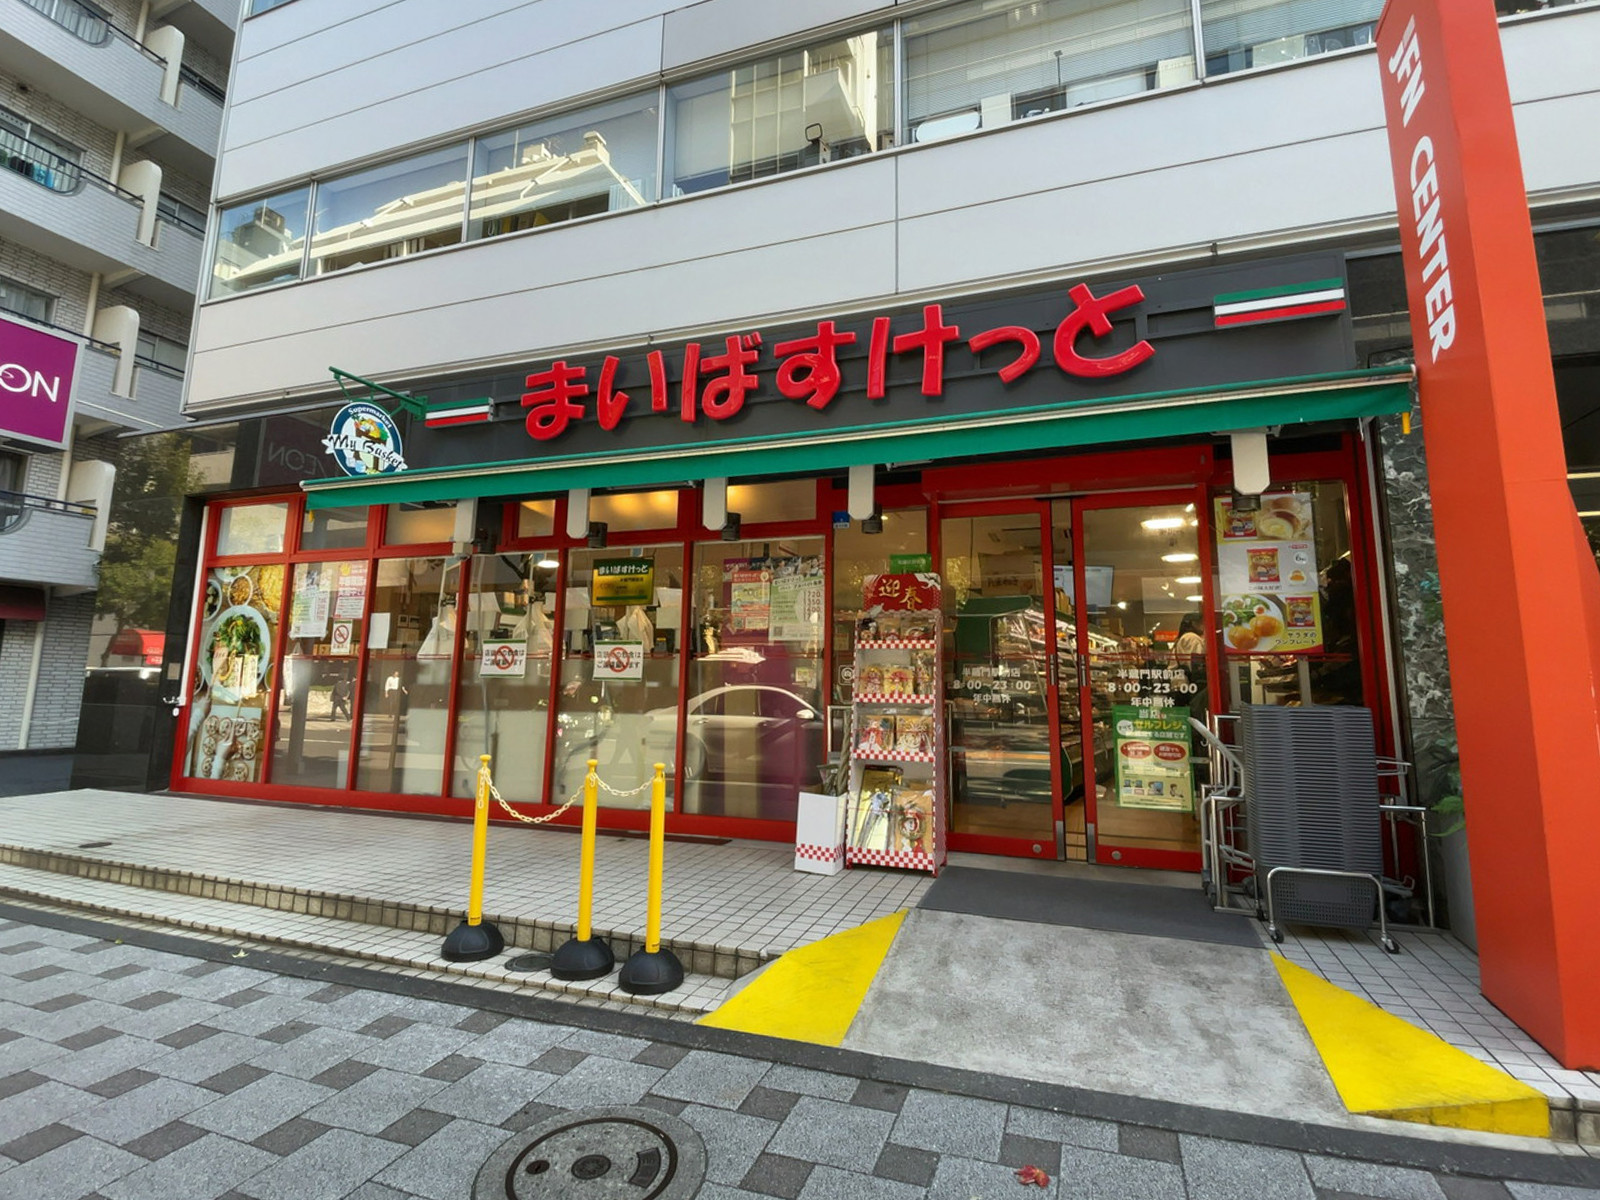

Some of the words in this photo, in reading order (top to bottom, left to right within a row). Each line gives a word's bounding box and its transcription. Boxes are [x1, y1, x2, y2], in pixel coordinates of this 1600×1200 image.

[1388, 14, 1426, 128] JFN
[1410, 135, 1457, 365] CENTER
[521, 283, 1156, 440] まいばすけっと
[0, 363, 60, 402] ON
[347, 406, 392, 429] Supermarket
[328, 434, 357, 452] My
[362, 440, 402, 469] Basket
[599, 564, 649, 575] まいばすけっと
[879, 578, 923, 611] 迎春
[1117, 668, 1185, 679] 半蔵門駅前店
[1131, 696, 1175, 708] 年中無休
